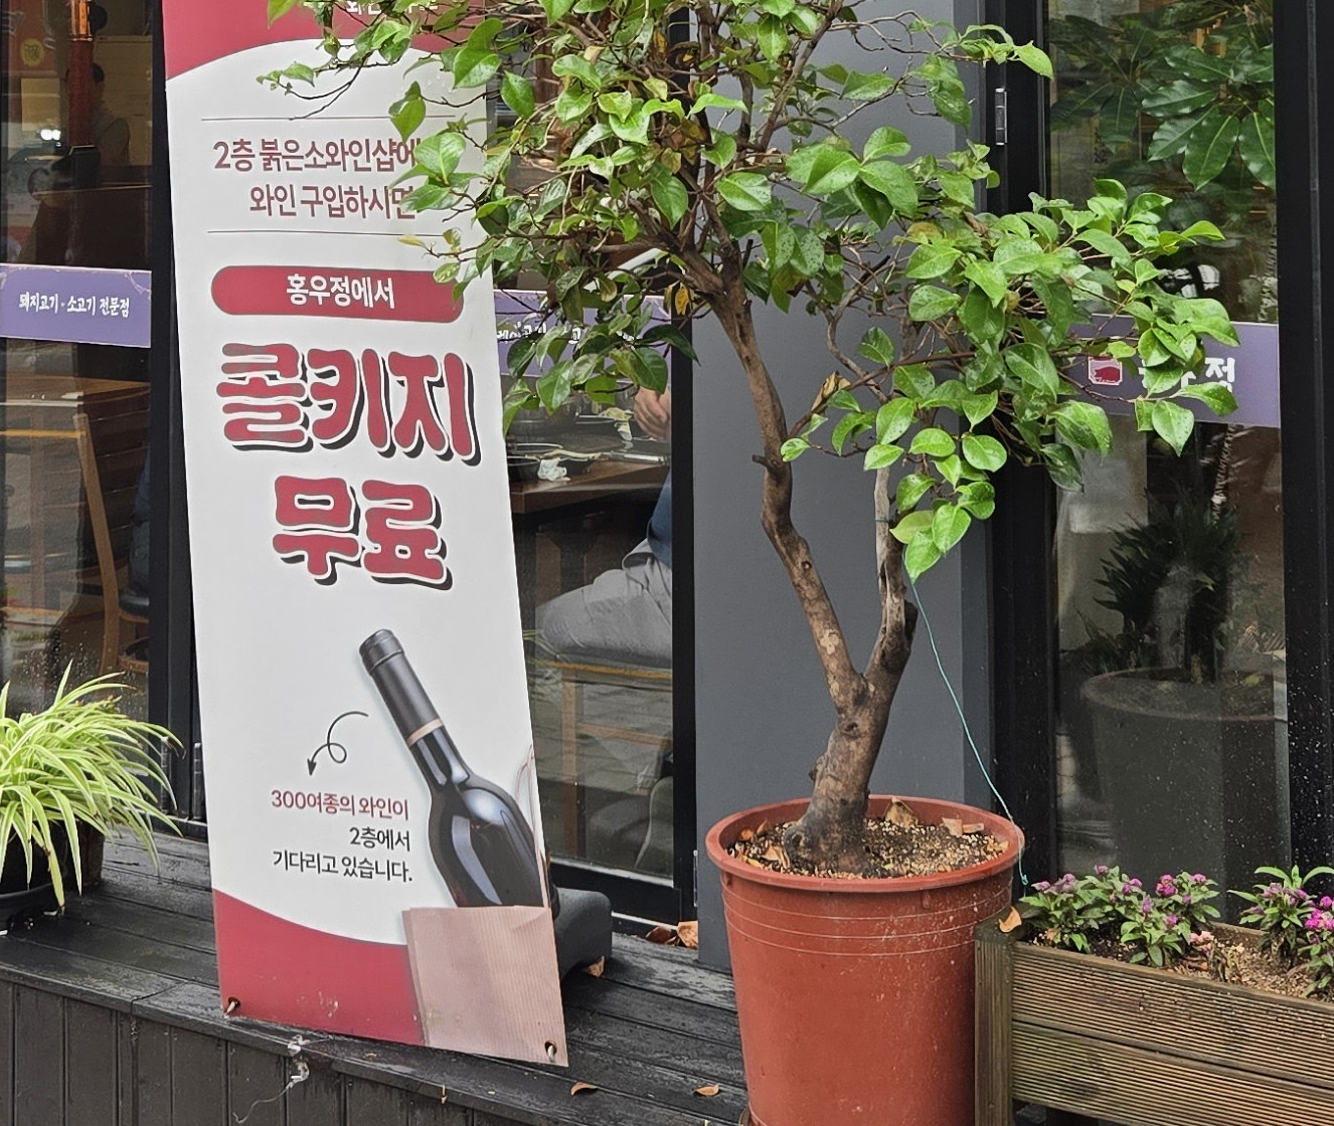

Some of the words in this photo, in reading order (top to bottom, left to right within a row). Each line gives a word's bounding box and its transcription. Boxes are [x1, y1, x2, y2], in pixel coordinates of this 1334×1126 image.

[213, 138, 256, 173] 2층
[98, 296, 130, 318] 전문점
[286, 273, 395, 309] 홍우정에서
[216, 342, 482, 466] 콜키지
[272, 474, 453, 592] 무료
[270, 789, 356, 817] 300여종의
[358, 798, 409, 821] 와인이
[349, 826, 411, 853] 2층에서
[272, 848, 339, 876] 기다리고
[340, 855, 414, 883] 있습니다.
